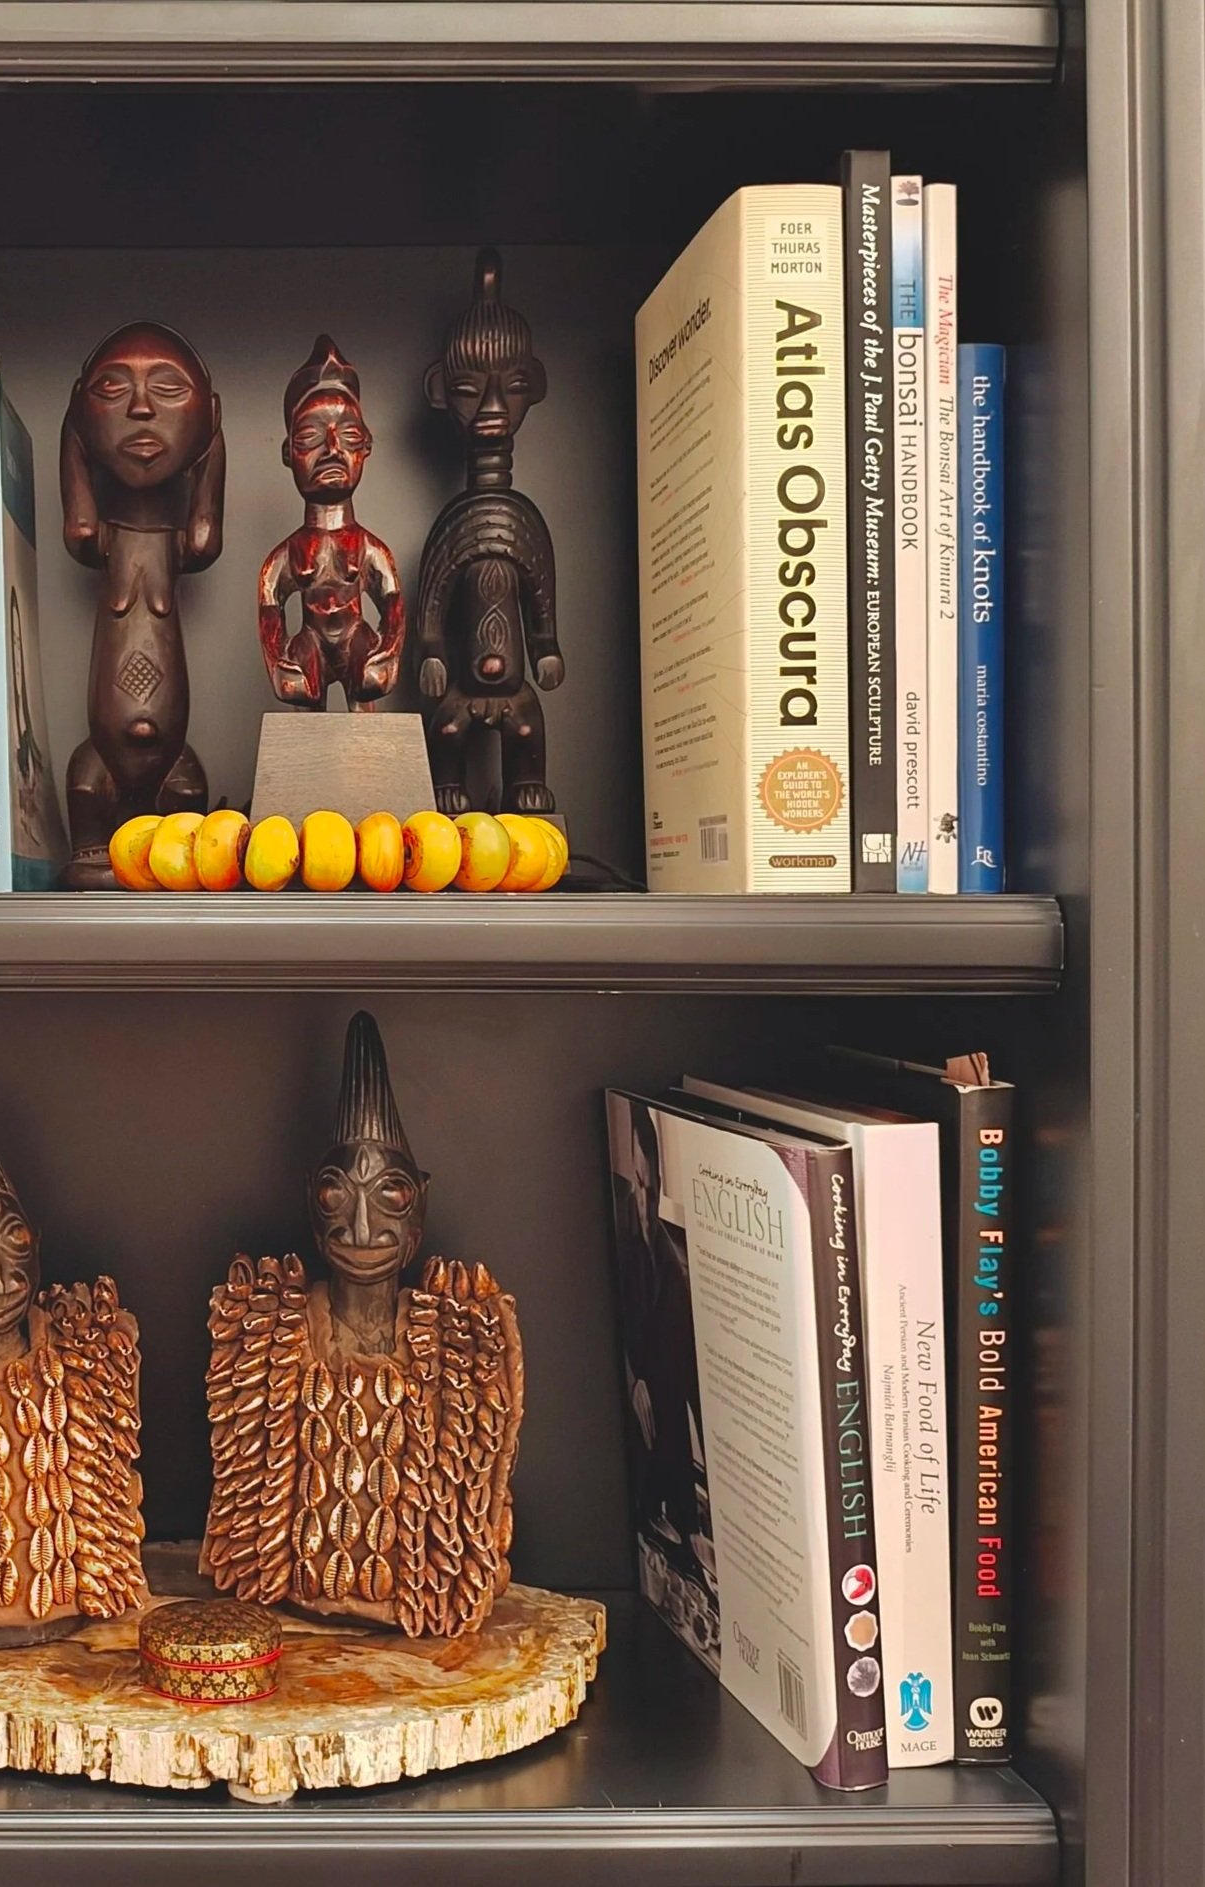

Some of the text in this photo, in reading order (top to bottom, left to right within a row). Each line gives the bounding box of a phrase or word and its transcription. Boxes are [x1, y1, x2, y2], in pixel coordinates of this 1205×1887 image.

[771, 242, 821, 254] THURAS
[771, 261, 822, 274] MORTON
[780, 222, 812, 235] FOER
[648, 332, 677, 386] Discover
[898, 280, 923, 550] THE bonsai HANDBOOK
[859, 183, 885, 766] Masterpieces of the J. Paul Getty Museum: EUROPEAN SCULPTURE
[934, 275, 956, 620] The Magician The Bonsai Art of Kimura 2
[973, 375, 997, 624] the handbook of knots
[775, 300, 829, 727] Atlas Obscura
[903, 691, 921, 810] david prescott
[976, 664, 991, 786] maria costantino
[771, 855, 835, 867] workman
[691, 1178, 784, 1249] ENGLISH
[829, 1174, 867, 1540] Cooking in Everyday ENGLISH
[913, 1320, 942, 1515] New Food of Life
[973, 1129, 1006, 1597] Bobby Flay's Bold American Food
[901, 1740, 938, 1752] MAGE
